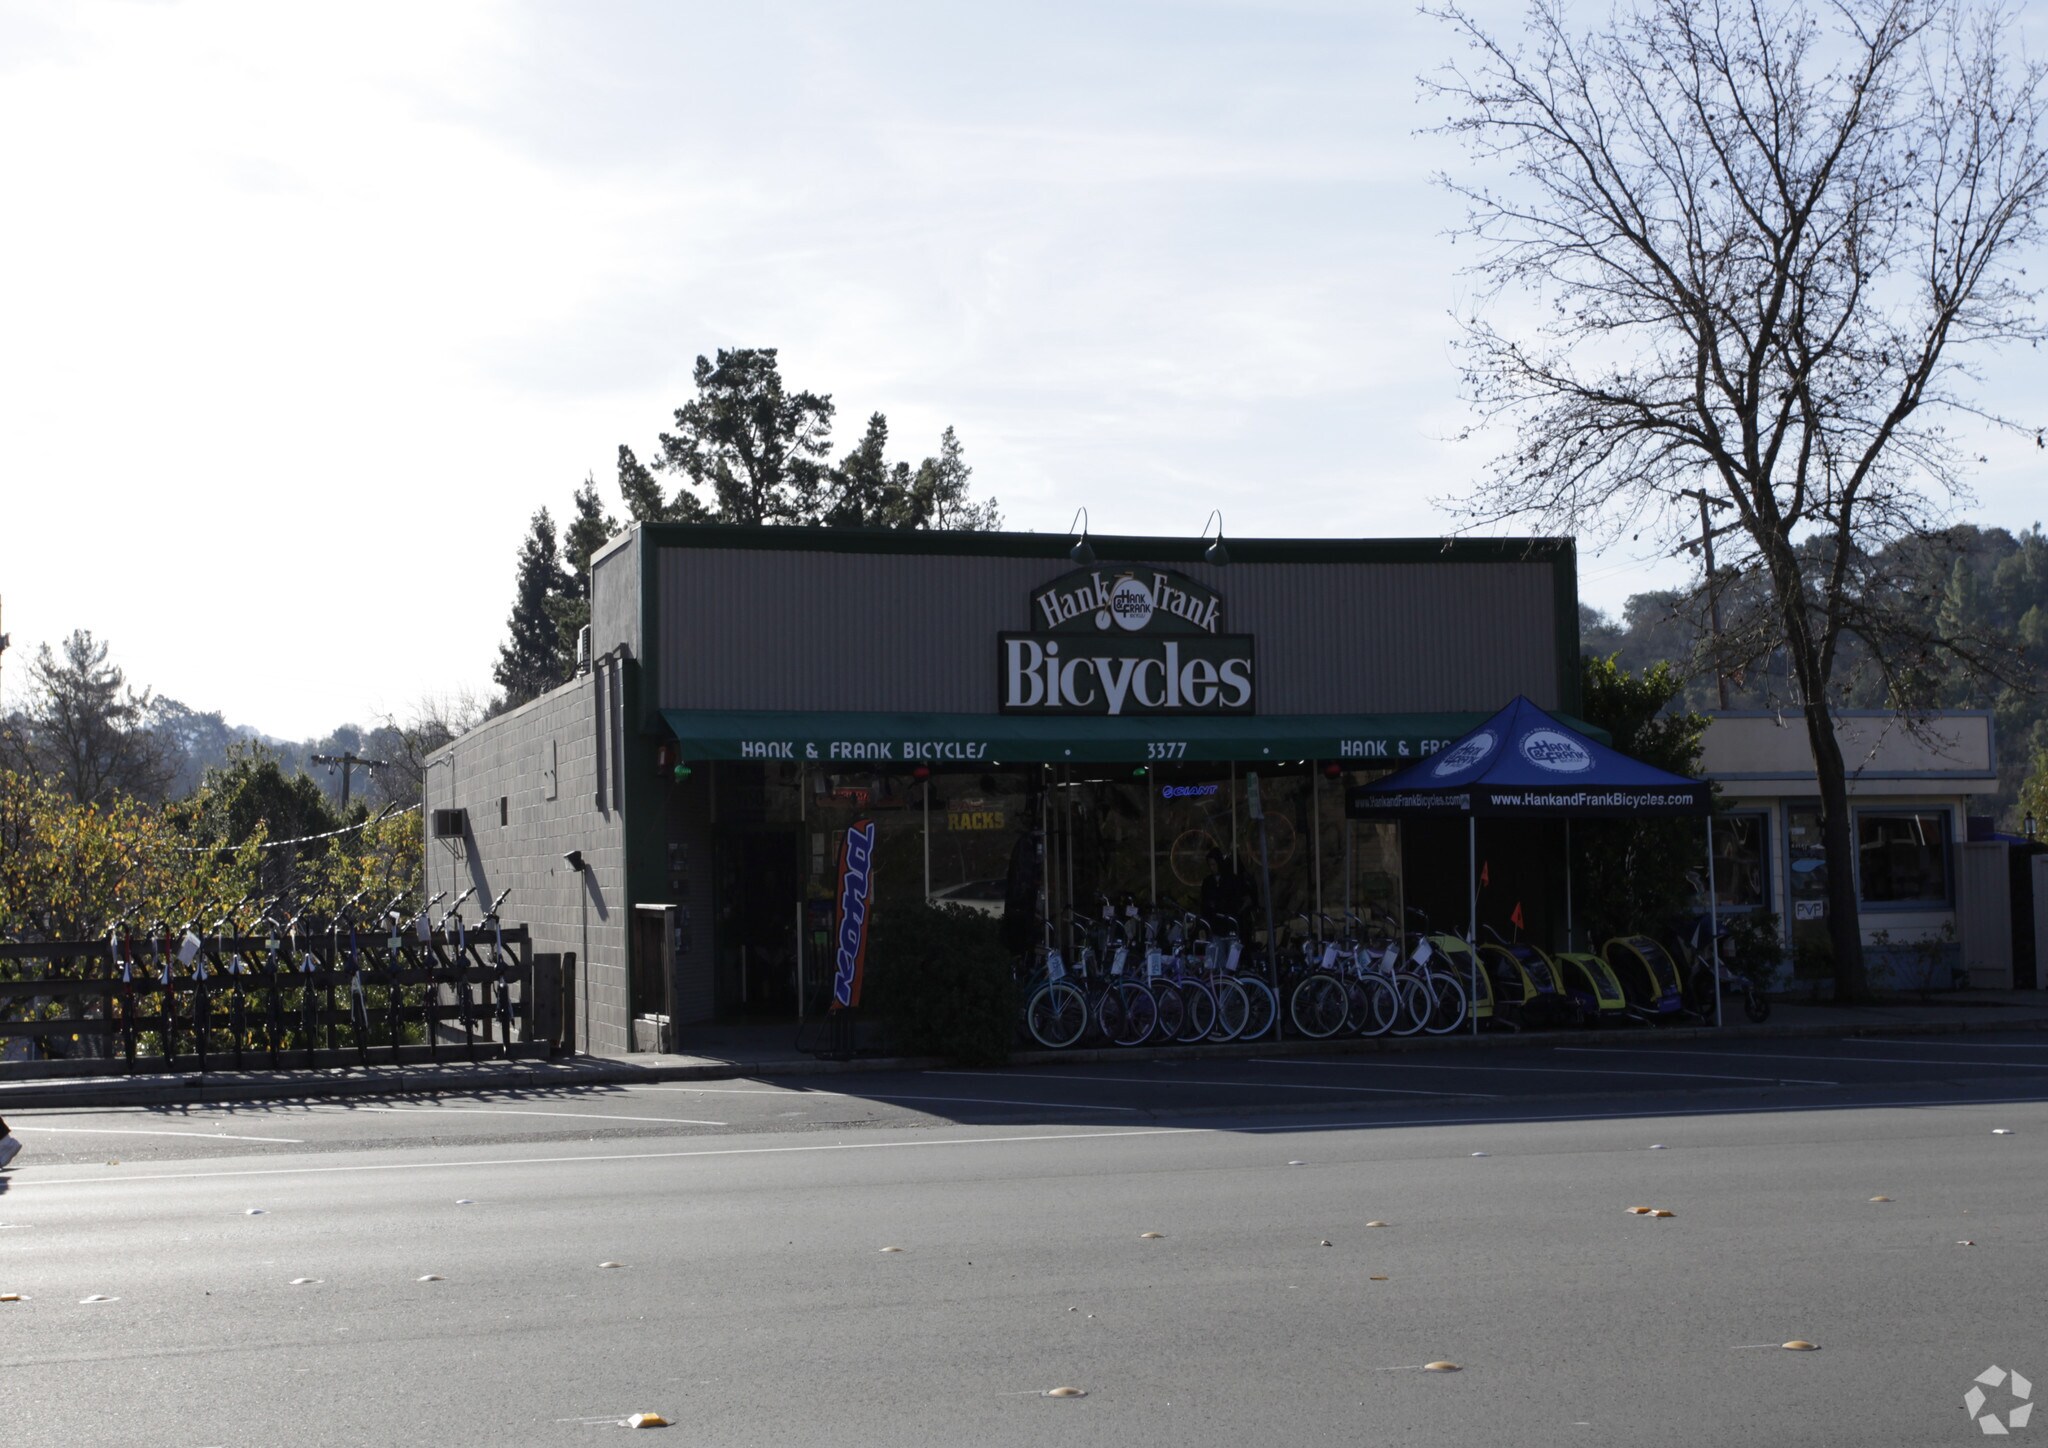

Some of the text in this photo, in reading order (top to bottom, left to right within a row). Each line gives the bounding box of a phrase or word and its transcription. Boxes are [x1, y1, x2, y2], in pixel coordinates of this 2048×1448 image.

[1037, 572, 1220, 633] Hank Frank
[1005, 640, 1251, 715] Bicycles
[741, 741, 987, 759] HANK & FRANK BICYCLES
[1147, 742, 1187, 759] 3377
[1340, 740, 1388, 756] HANK
[1398, 740, 1409, 756] &
[1491, 792, 1693, 809] www.HankandFrankBicycles.com
[947, 812, 1005, 830] RACKS
[1797, 903, 1822, 916] PVP
